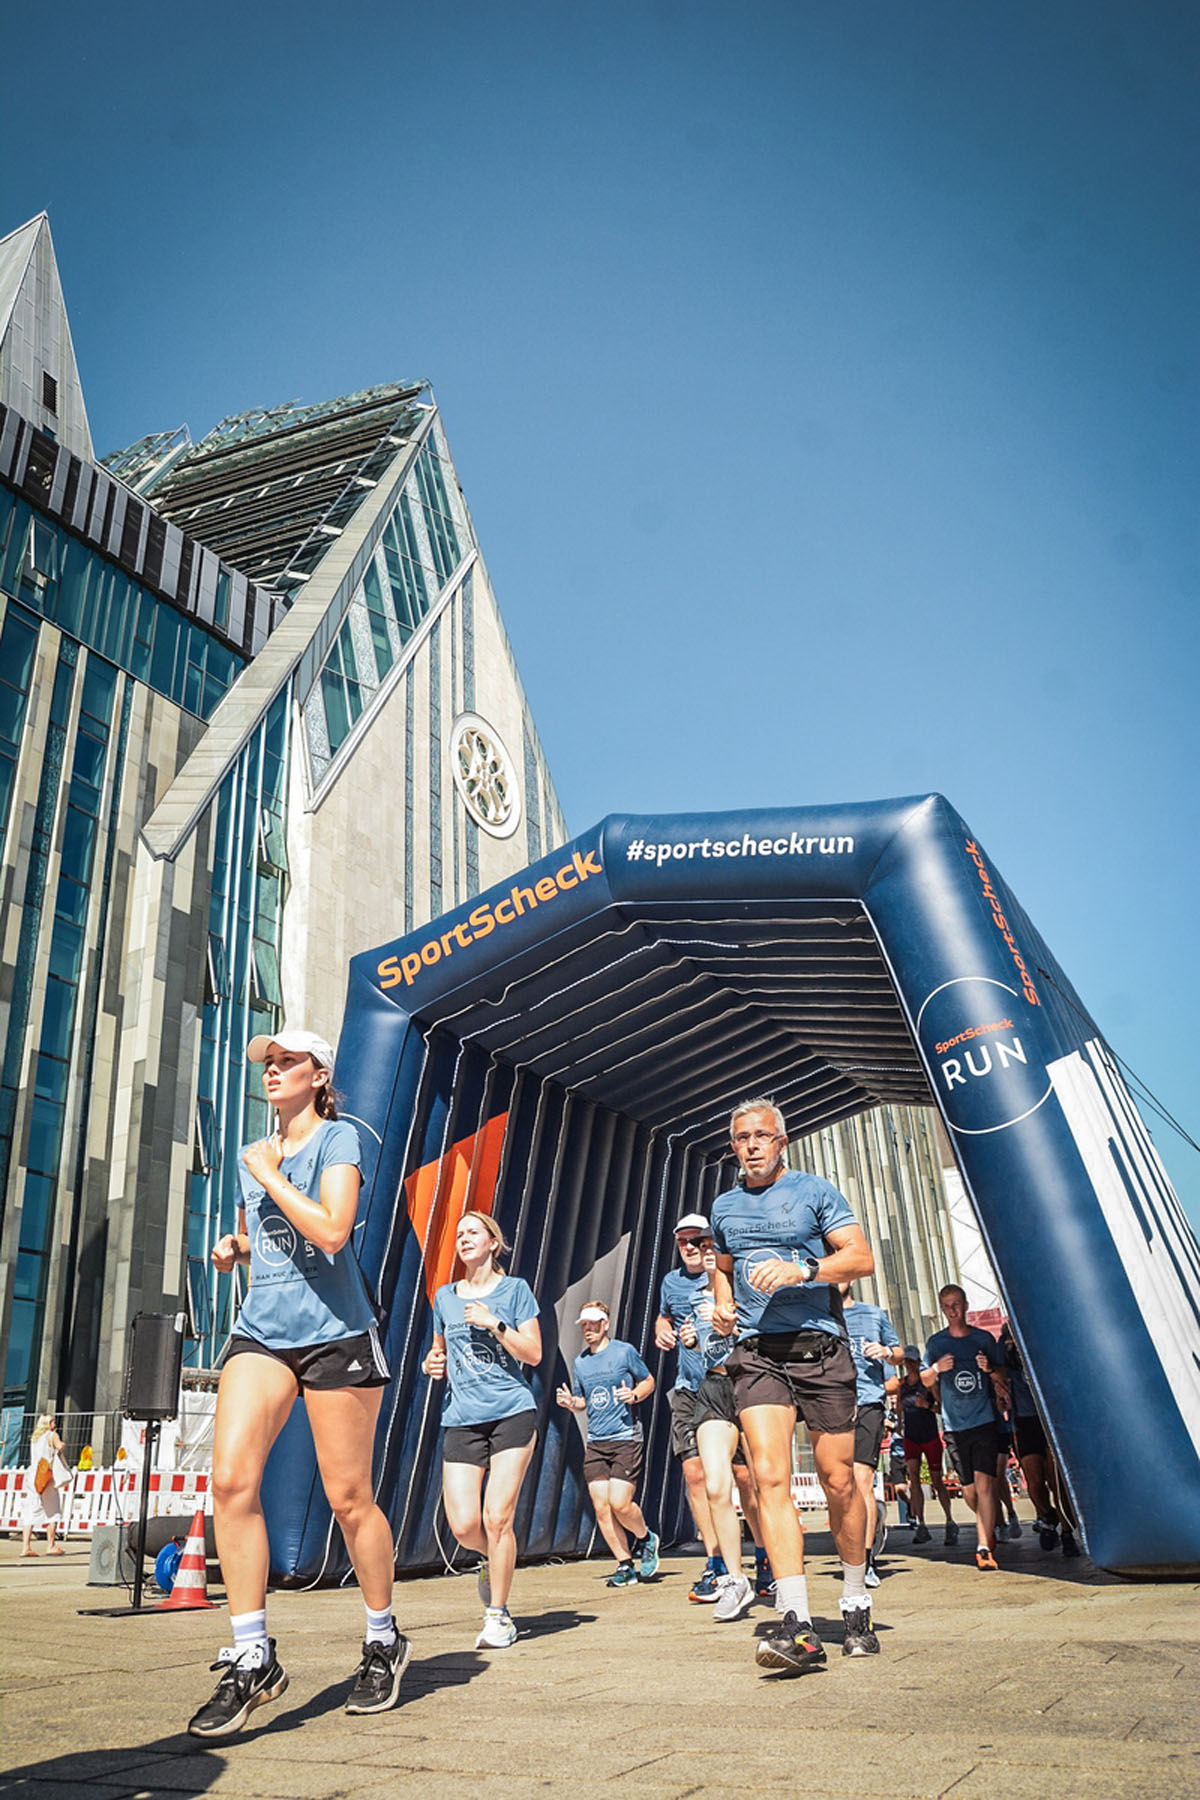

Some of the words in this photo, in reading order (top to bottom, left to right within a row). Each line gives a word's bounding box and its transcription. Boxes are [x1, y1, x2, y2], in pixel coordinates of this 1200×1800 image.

[626, 831, 854, 867] #sportscheckrun
[376, 849, 603, 989] SportScheck
[965, 839, 1041, 1007] SportScheck
[934, 1017, 1014, 1055] SportScheck
[941, 1037, 1028, 1091] RUN
[262, 1236, 292, 1254] RUN
